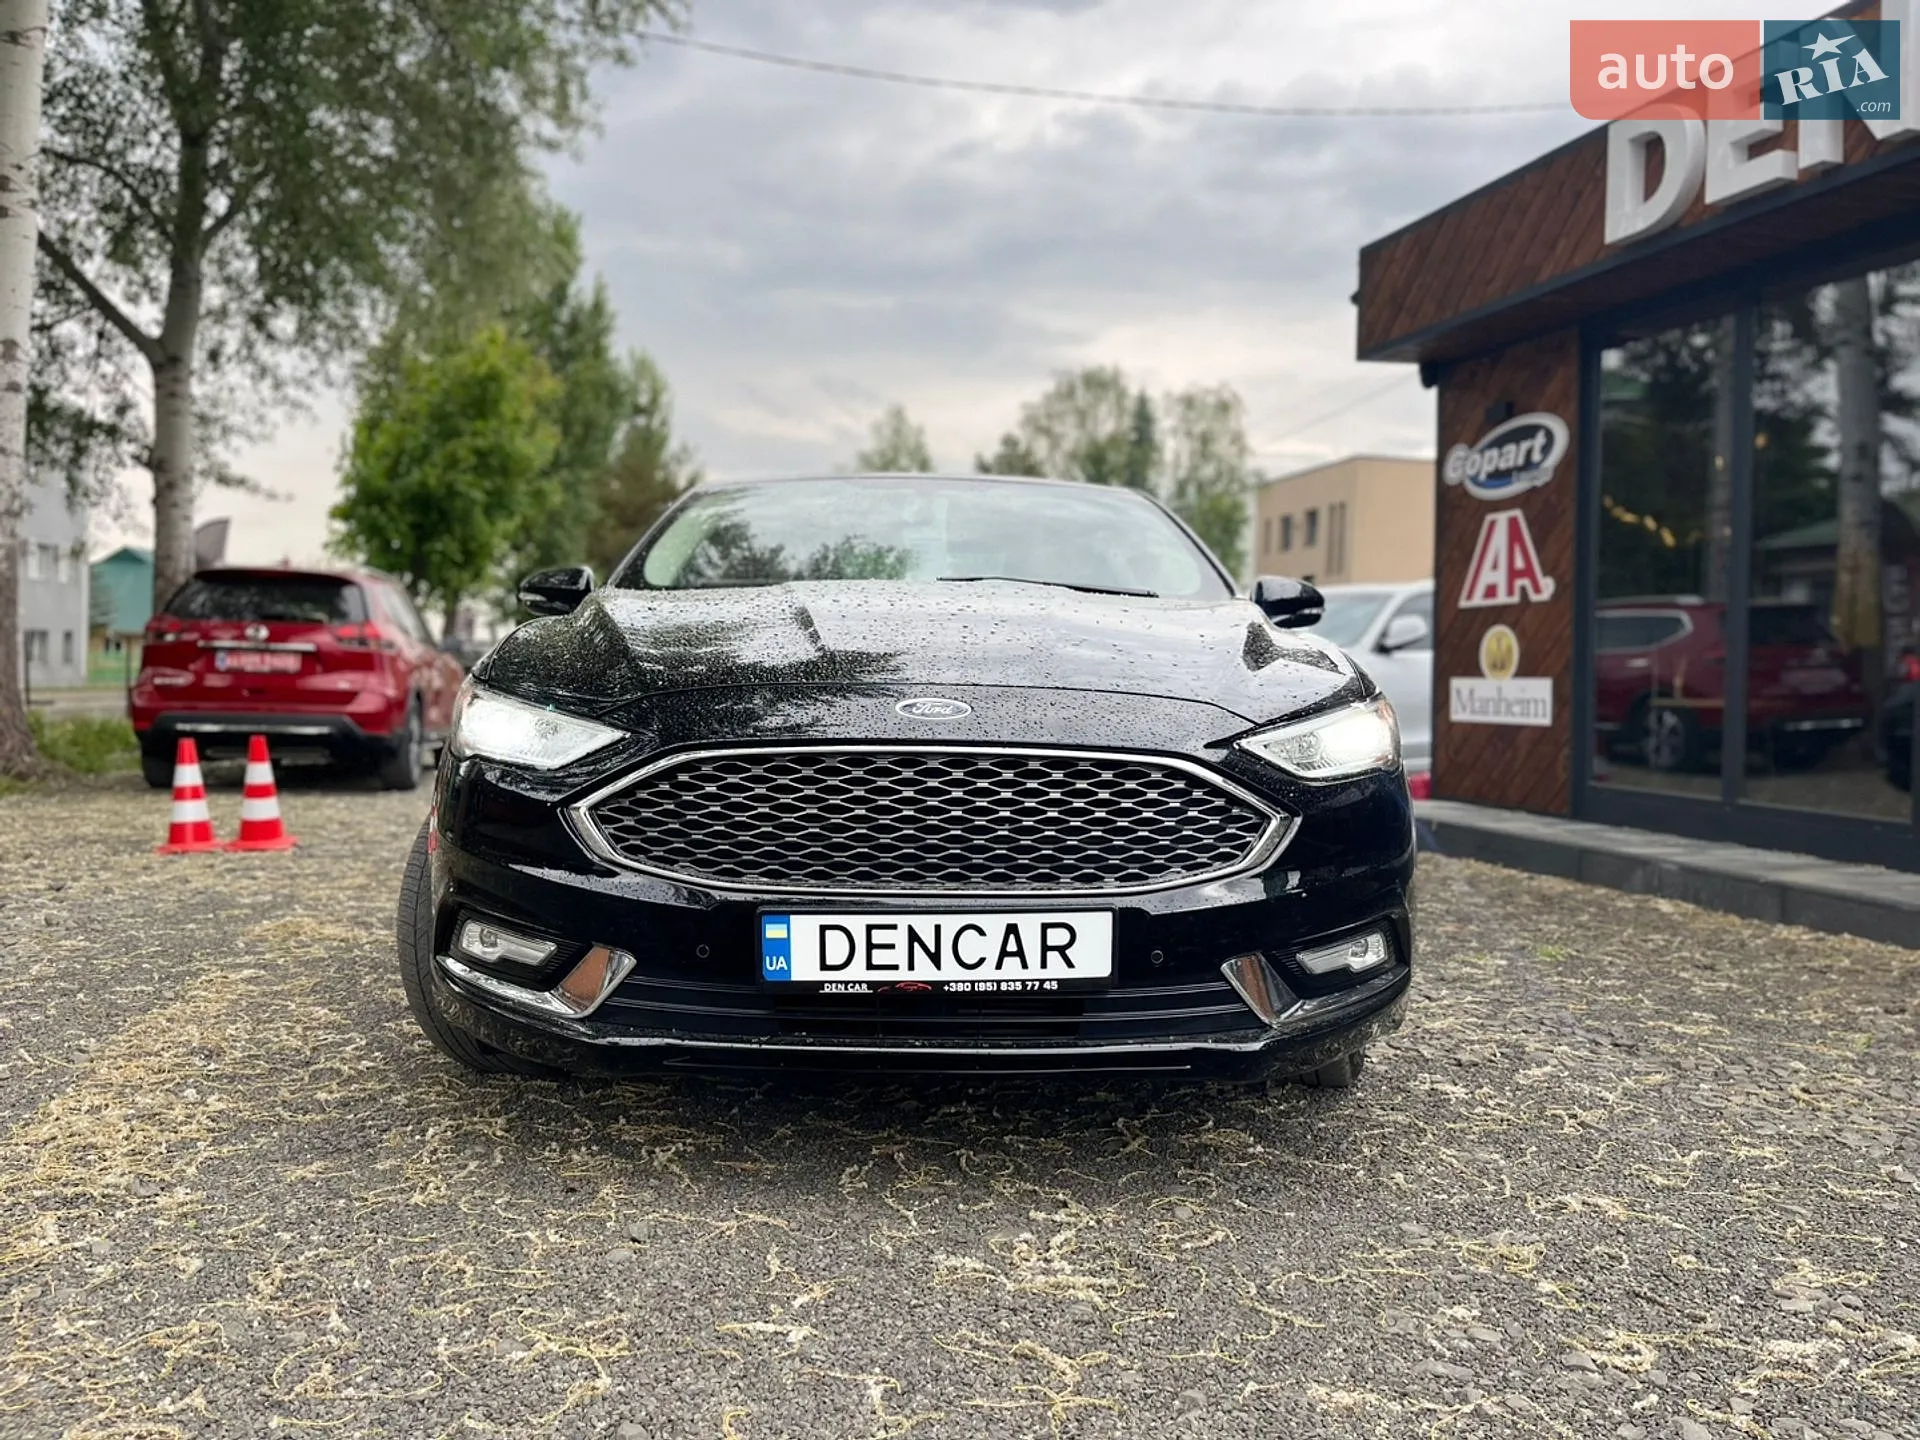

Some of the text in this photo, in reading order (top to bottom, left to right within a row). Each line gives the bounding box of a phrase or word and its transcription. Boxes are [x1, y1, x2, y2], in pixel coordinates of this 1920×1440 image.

[1444, 428, 1548, 483] Copart
[912, 702, 953, 715] Ford
[1453, 685, 1548, 719] Manheim
[818, 921, 1078, 972] DENCAR
[765, 956, 788, 971] UA
[823, 982, 868, 992] DEN CAR
[943, 980, 1058, 992] +380 (95) 835 77 45
